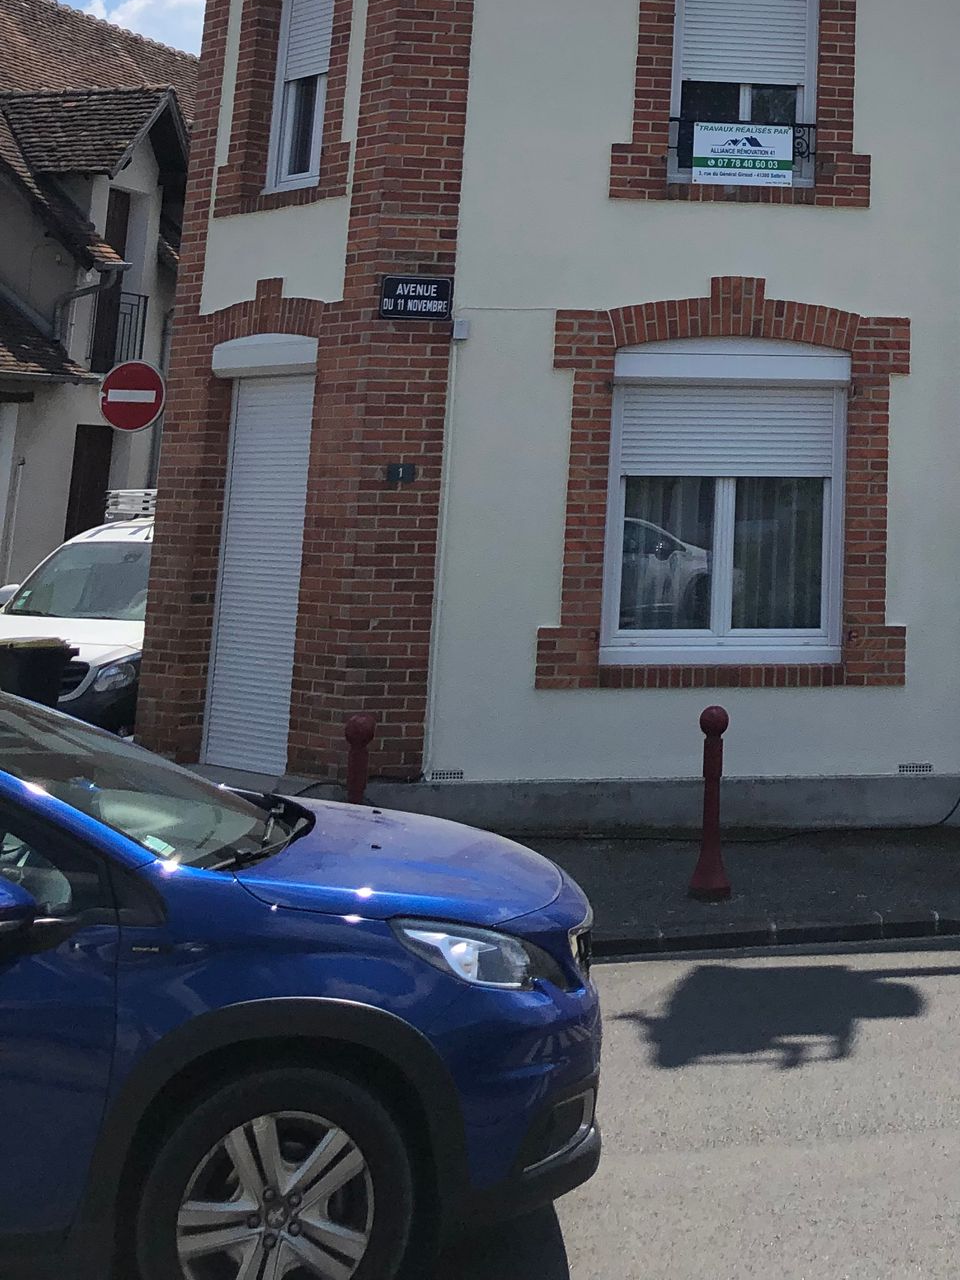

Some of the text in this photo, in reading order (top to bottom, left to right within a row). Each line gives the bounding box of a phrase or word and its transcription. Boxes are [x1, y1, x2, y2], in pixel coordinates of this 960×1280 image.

[700, 125, 734, 133] TRAVAUX
[735, 126, 772, 134] RÉALISÉS
[717, 159, 778, 169] 07 78 40 60 03
[396, 283, 438, 297] AVENUE
[383, 298, 448, 312] DU 11 NOVEMBRE
[398, 467, 403, 478] 1
